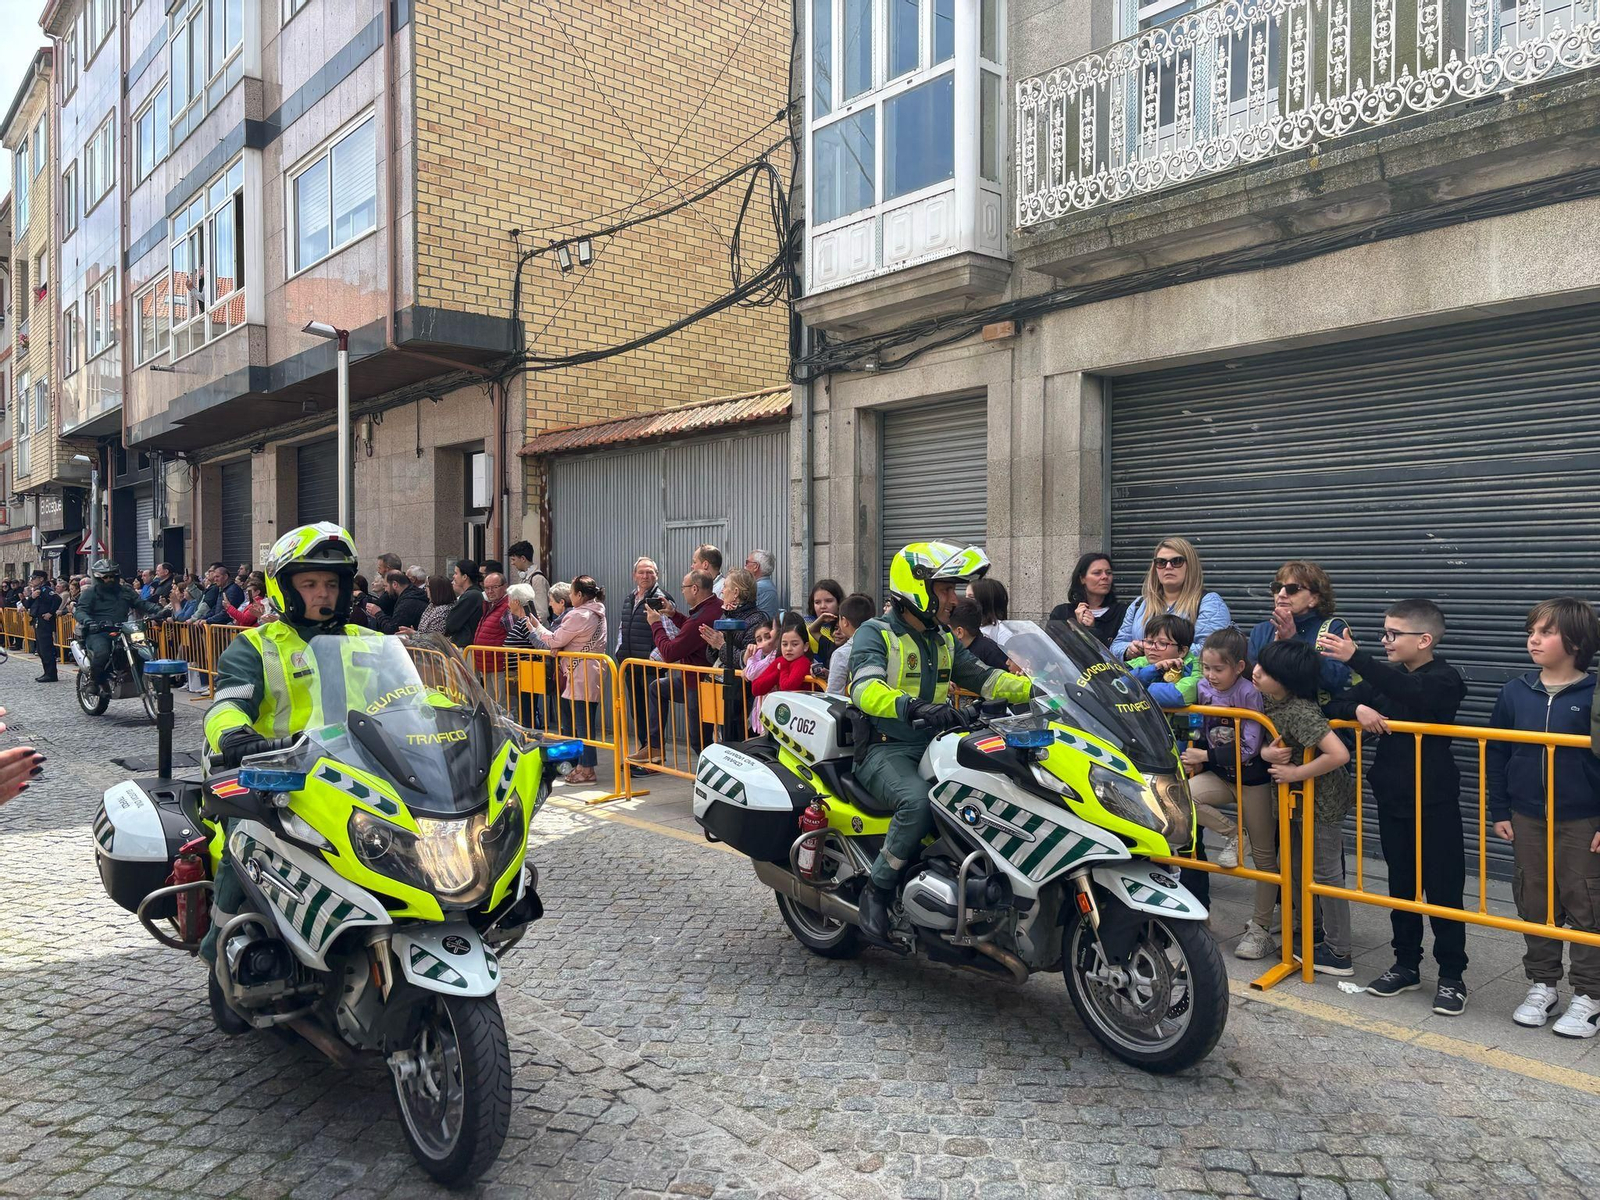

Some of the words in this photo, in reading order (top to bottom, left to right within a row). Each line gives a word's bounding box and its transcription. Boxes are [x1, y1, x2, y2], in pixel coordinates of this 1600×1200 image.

[1076, 662, 1115, 688] GUARDIA
[366, 684, 434, 715] GUARDIA
[436, 684, 469, 705] CIVIL
[796, 717, 816, 735] 062
[406, 729, 468, 746] TRAFICO
